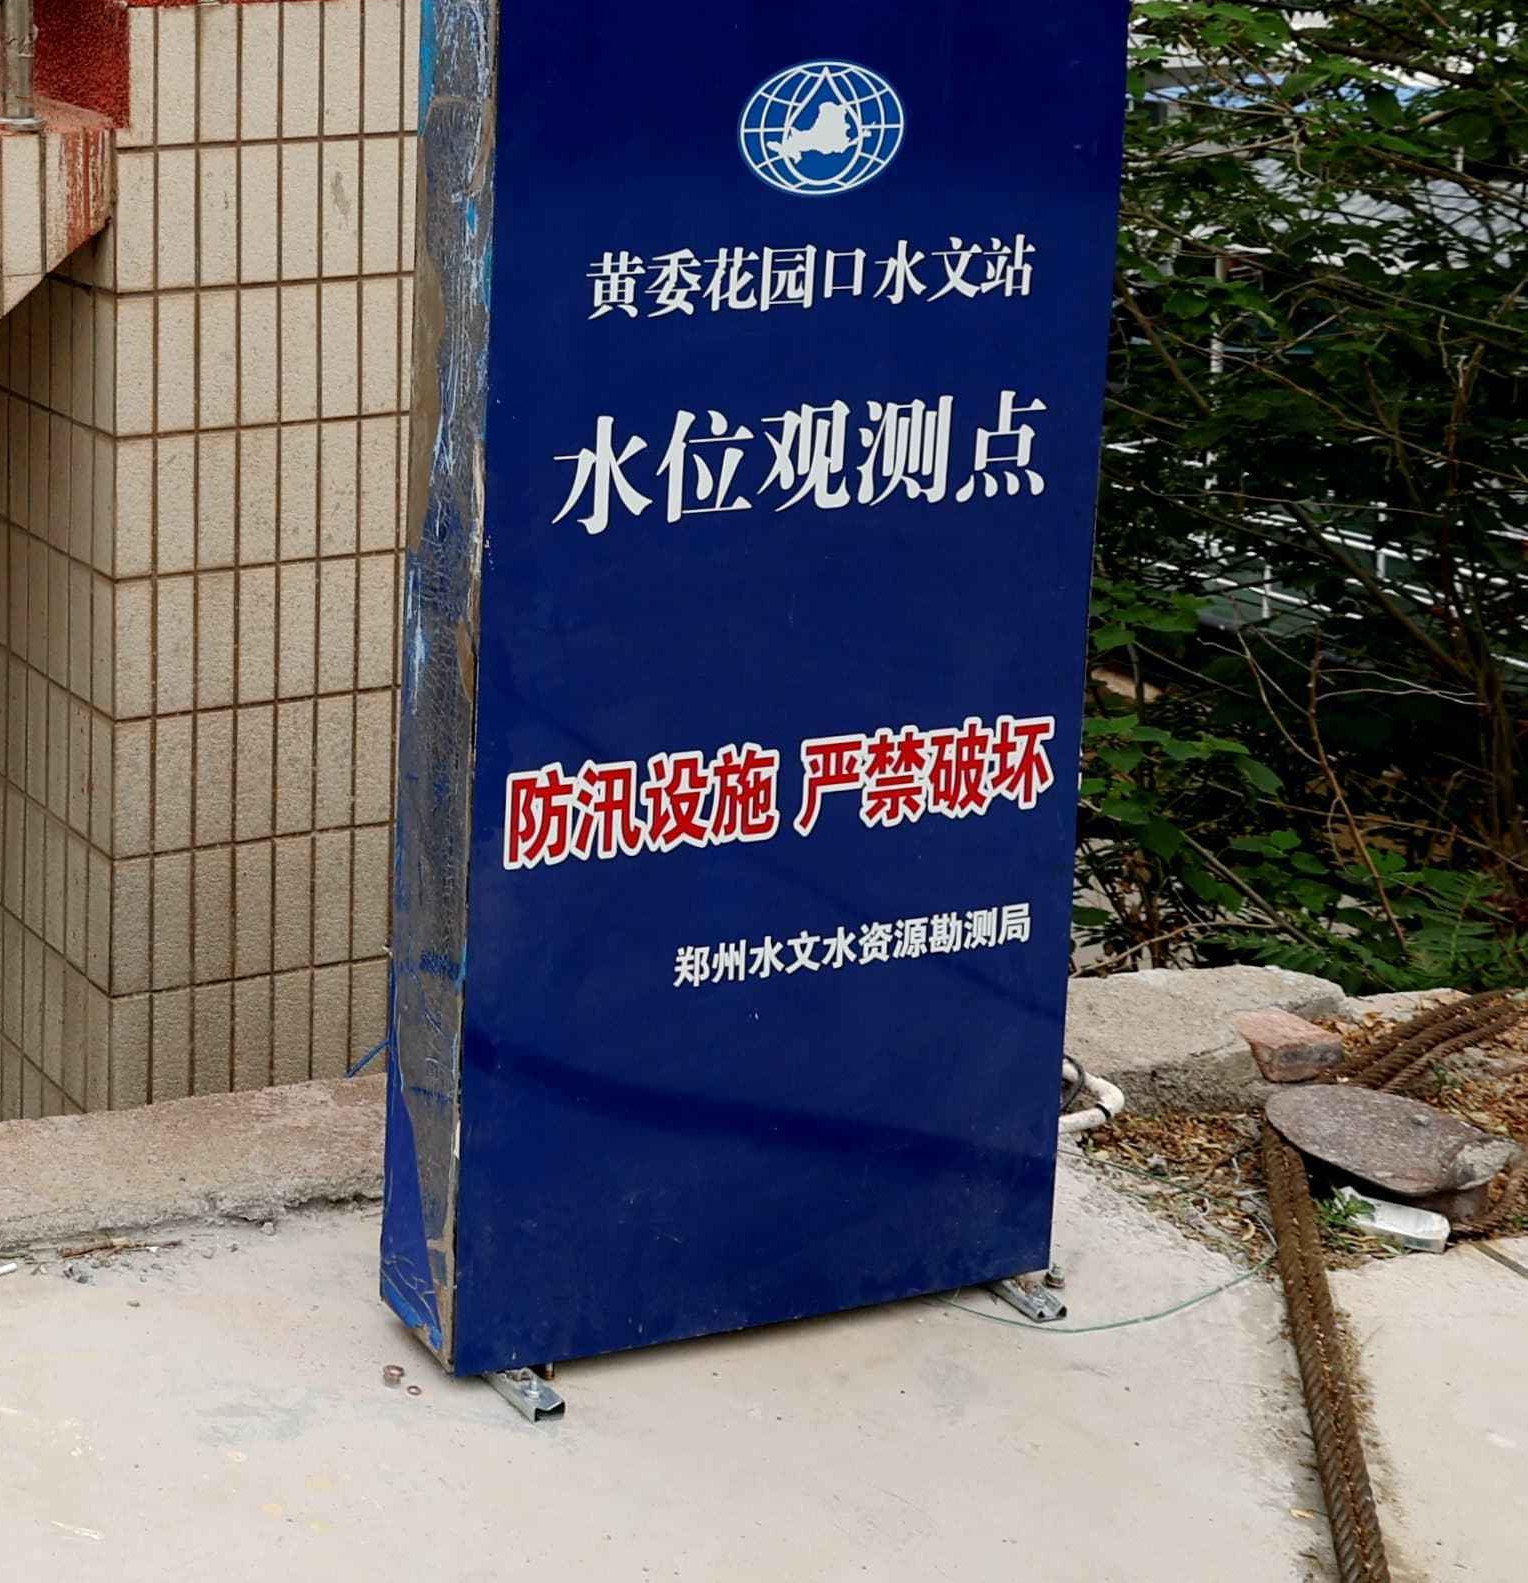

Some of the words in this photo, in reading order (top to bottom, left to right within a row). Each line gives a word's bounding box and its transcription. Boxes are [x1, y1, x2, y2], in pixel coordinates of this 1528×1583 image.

[586, 233, 1037, 320] 黄委花园口水文站
[551, 390, 1048, 535] 水位观测点
[503, 742, 781, 871] 防汛设施
[793, 714, 1057, 837] 严禁破坏
[673, 902, 1032, 987] 郑州水文水资源勘测局
